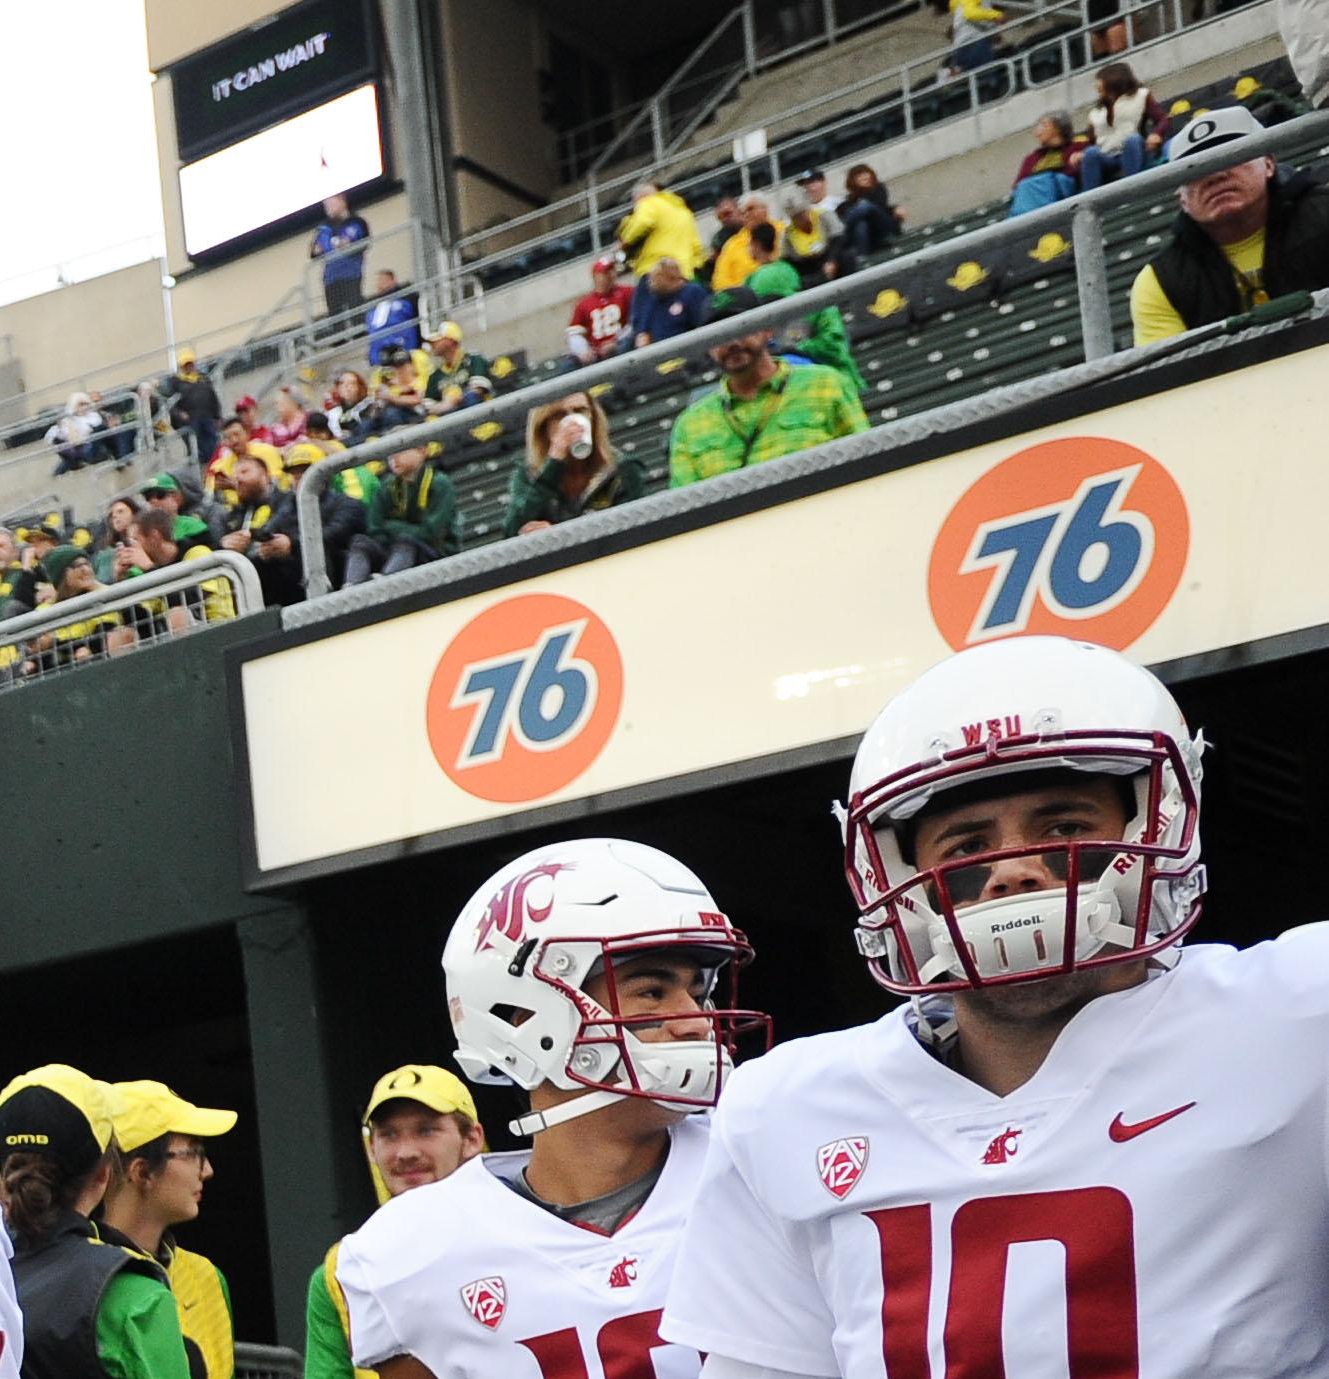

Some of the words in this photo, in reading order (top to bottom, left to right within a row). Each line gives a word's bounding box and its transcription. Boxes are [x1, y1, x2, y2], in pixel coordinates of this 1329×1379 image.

[212, 77, 232, 102] IT
[232, 58, 276, 91] CAN
[274, 32, 329, 72] WAIT
[957, 461, 1158, 645] 76
[451, 617, 598, 771] 76
[961, 713, 1022, 746] WSU
[990, 914, 1042, 934] Riddell
[818, 1139, 867, 1179] PAC
[828, 1160, 856, 1189] 12
[461, 1277, 506, 1313] PAC
[476, 1298, 502, 1323] 12
